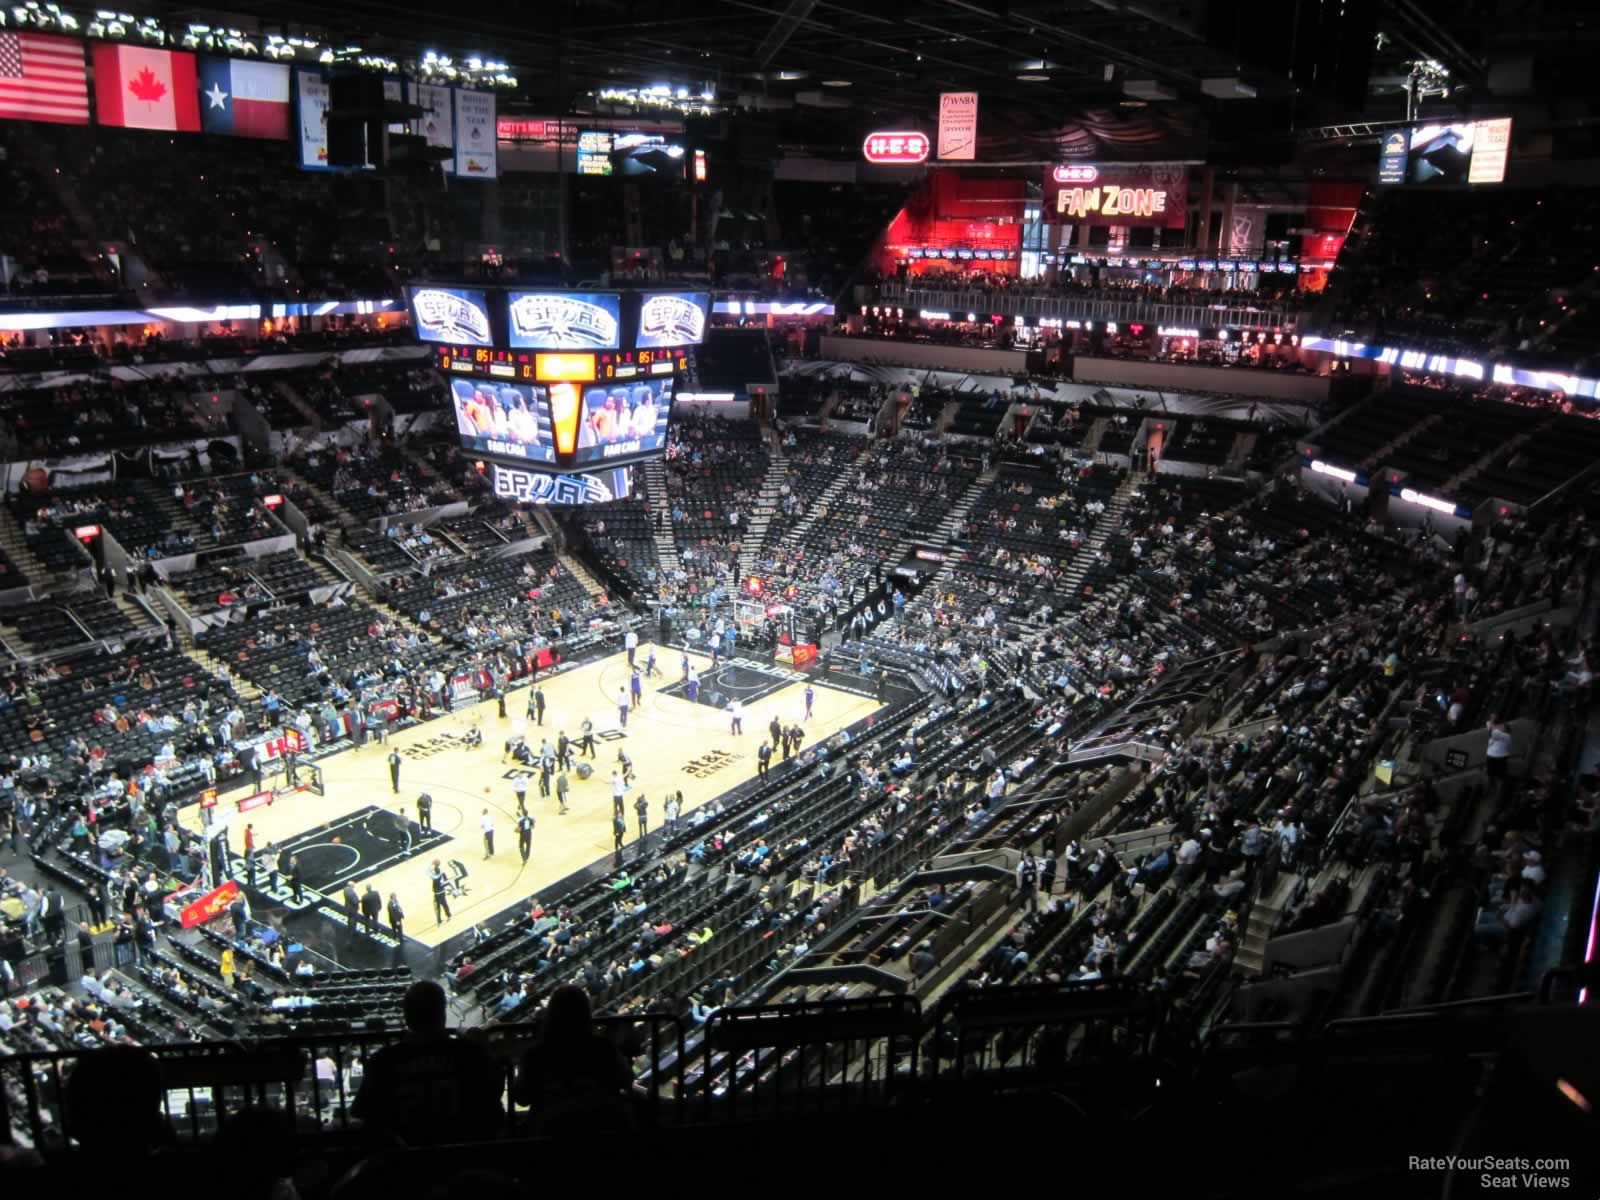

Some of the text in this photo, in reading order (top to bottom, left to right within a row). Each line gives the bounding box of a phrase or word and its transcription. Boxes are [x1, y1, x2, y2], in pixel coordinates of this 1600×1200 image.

[950, 96, 975, 104] WNBA
[871, 138, 923, 155] H-E-B
[1057, 185, 1167, 217] FAN ZONE
[731, 657, 811, 682] SPURS
[681, 749, 731, 774] at&t
